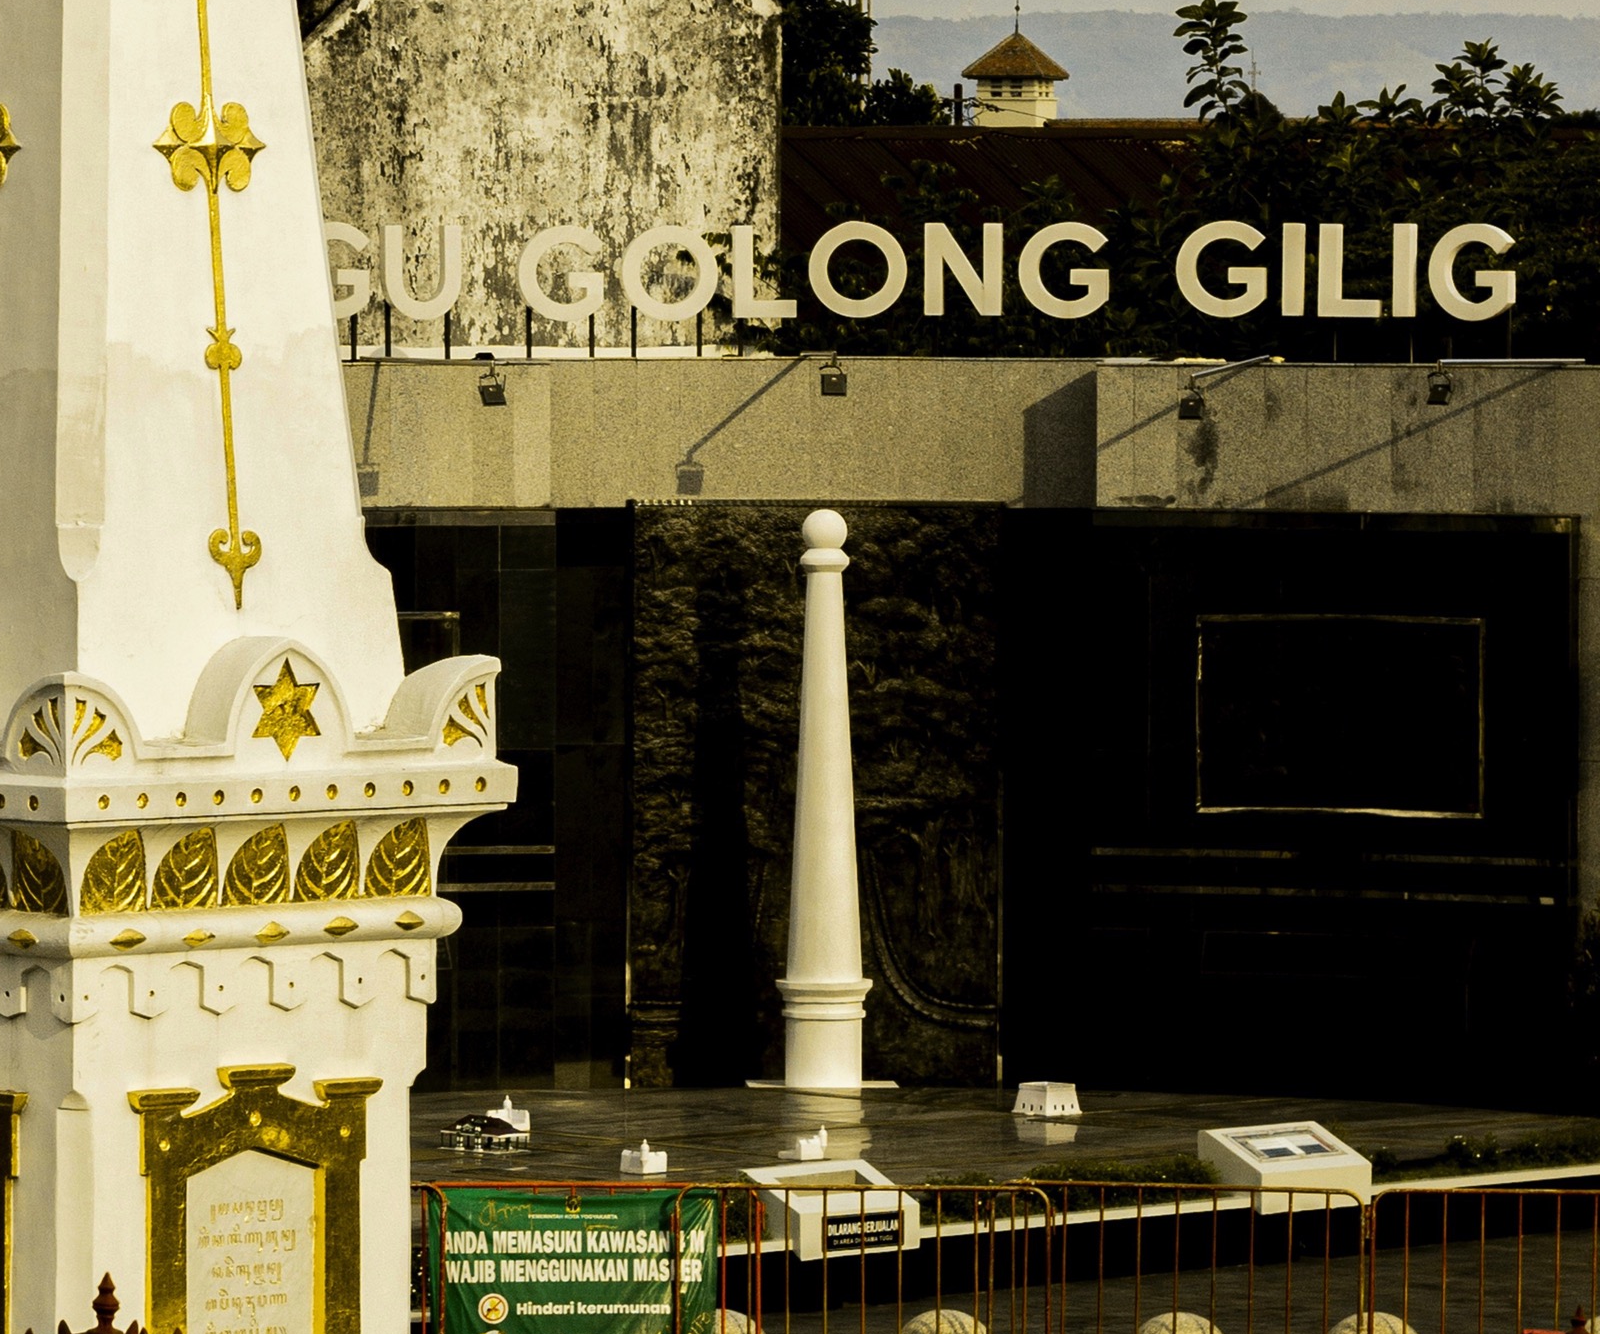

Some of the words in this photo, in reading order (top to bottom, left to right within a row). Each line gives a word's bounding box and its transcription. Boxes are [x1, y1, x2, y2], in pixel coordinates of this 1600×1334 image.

[518, 222, 1110, 323] GOLONG
[1175, 218, 1517, 321] GILIG
[828, 1221, 862, 1237] DILARANG
[445, 1230, 488, 1255] ANDA
[493, 1230, 582, 1254] MEMASUKI
[587, 1229, 670, 1254] KAWASAN
[690, 1230, 705, 1254] M
[445, 1260, 496, 1284] WAJIB
[501, 1259, 628, 1284] MENGGUNAKAN
[516, 1301, 574, 1316] Hindari
[577, 1301, 671, 1315] kerumunan
